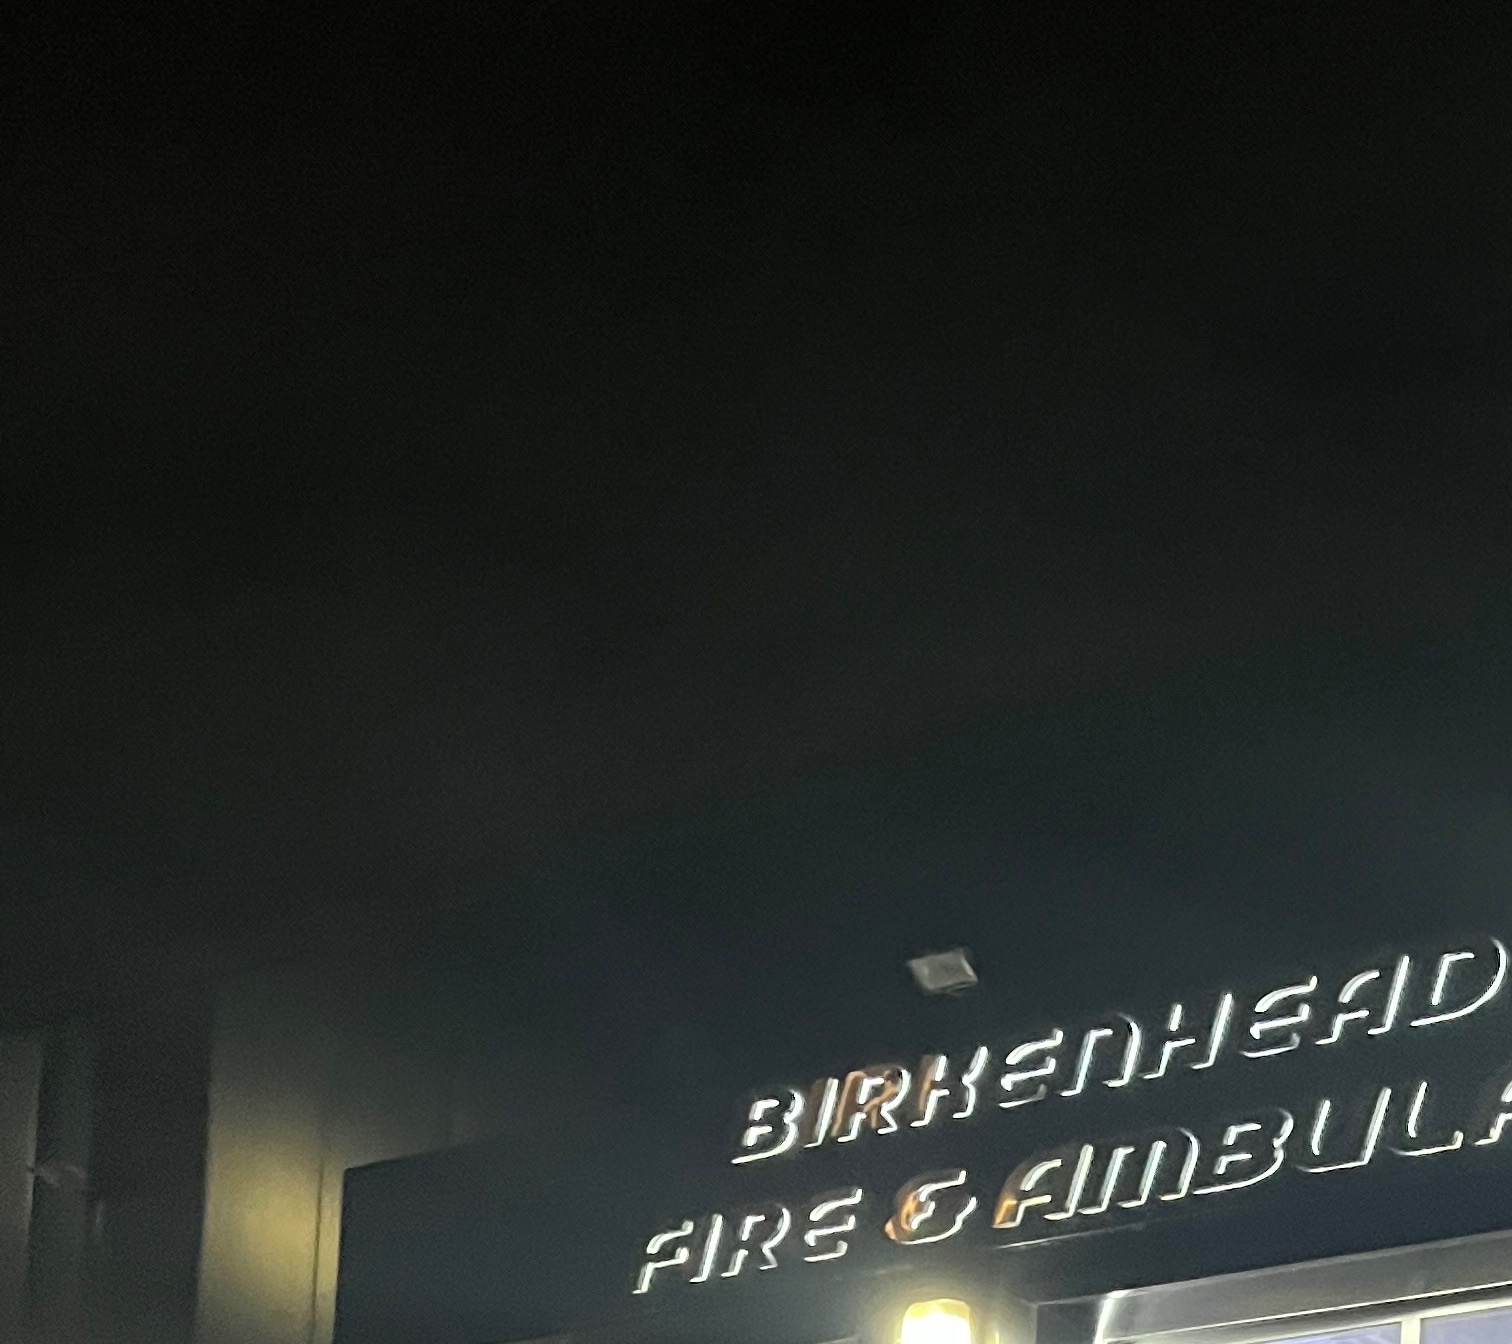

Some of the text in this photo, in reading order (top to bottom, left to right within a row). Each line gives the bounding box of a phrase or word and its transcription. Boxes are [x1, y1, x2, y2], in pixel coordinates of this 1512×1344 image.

[730, 935, 1510, 1165] BIRKENHEAD
[631, 1187, 865, 1295] FIRE
[883, 1167, 977, 1245] &
